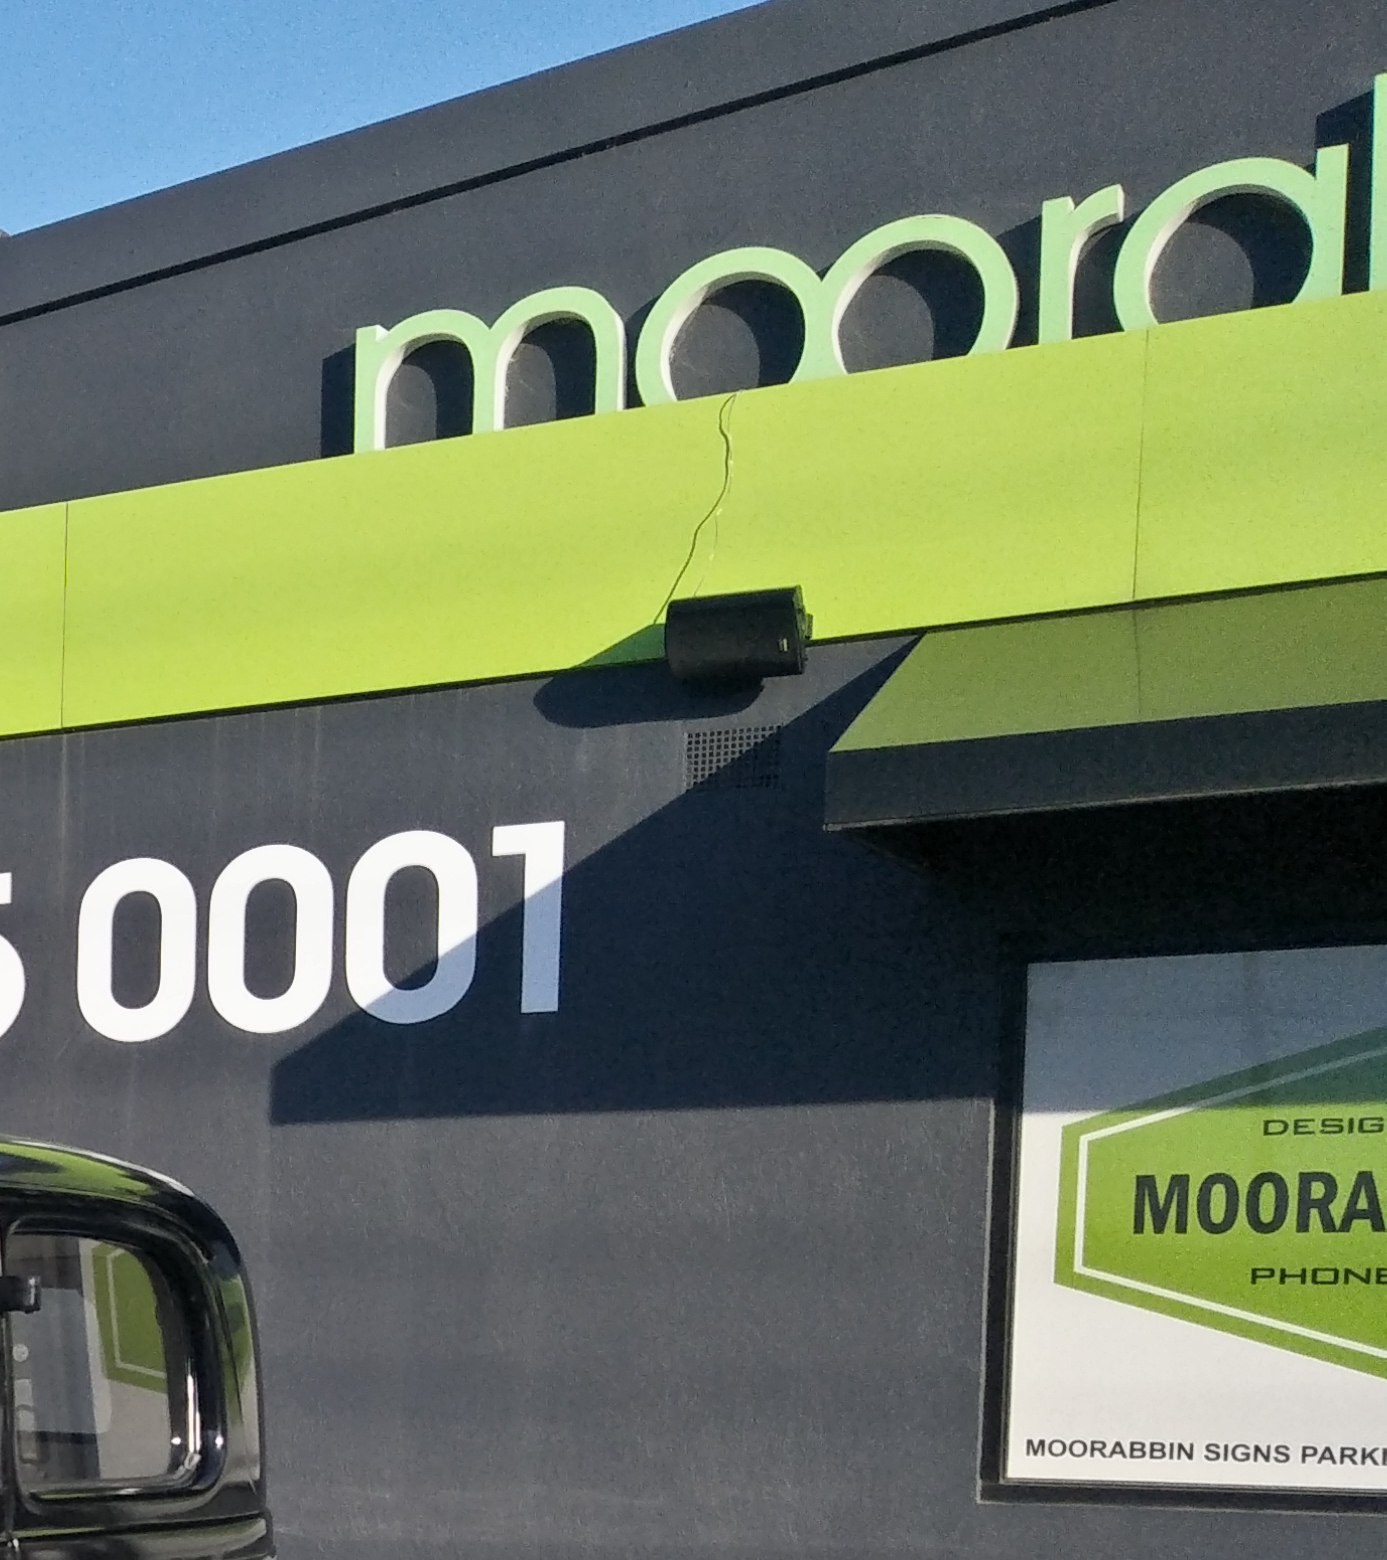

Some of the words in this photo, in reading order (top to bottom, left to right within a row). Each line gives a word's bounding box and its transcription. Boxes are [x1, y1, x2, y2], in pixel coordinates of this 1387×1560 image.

[77, 820, 566, 1043] 0001
[1262, 1117, 1384, 1136] DESIG
[1133, 1171, 1387, 1236] MOORA
[1025, 1438, 1195, 1462] MOORABBIN
[1204, 1442, 1291, 1464] SIGNS
